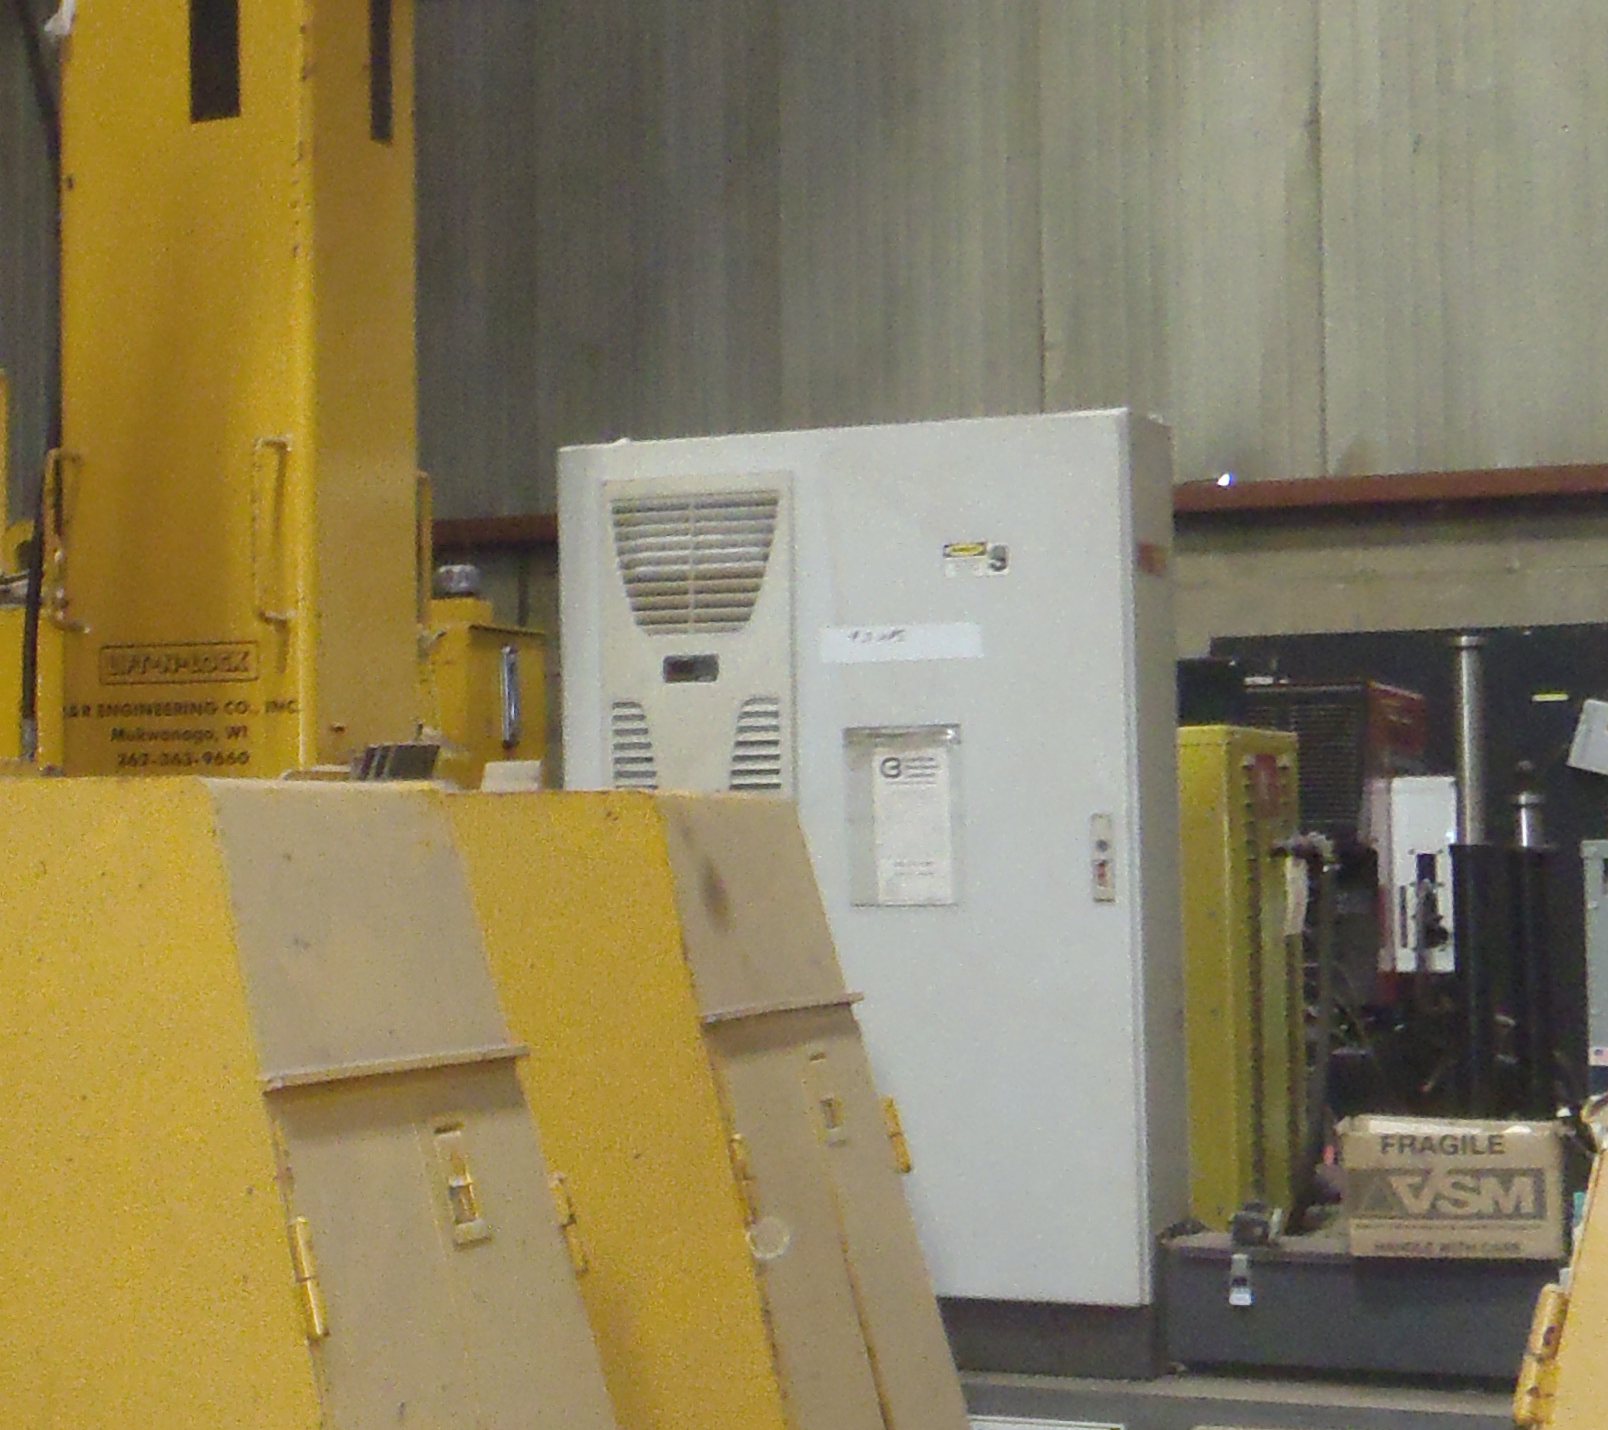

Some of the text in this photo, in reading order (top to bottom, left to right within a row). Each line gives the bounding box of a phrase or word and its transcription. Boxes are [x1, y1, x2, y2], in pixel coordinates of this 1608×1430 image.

[97, 700, 219, 719] ENGINEERING
[226, 723, 249, 739] WI
[1380, 1133, 1506, 1156] FRAGILE
[1390, 1173, 1536, 1216] VSM
